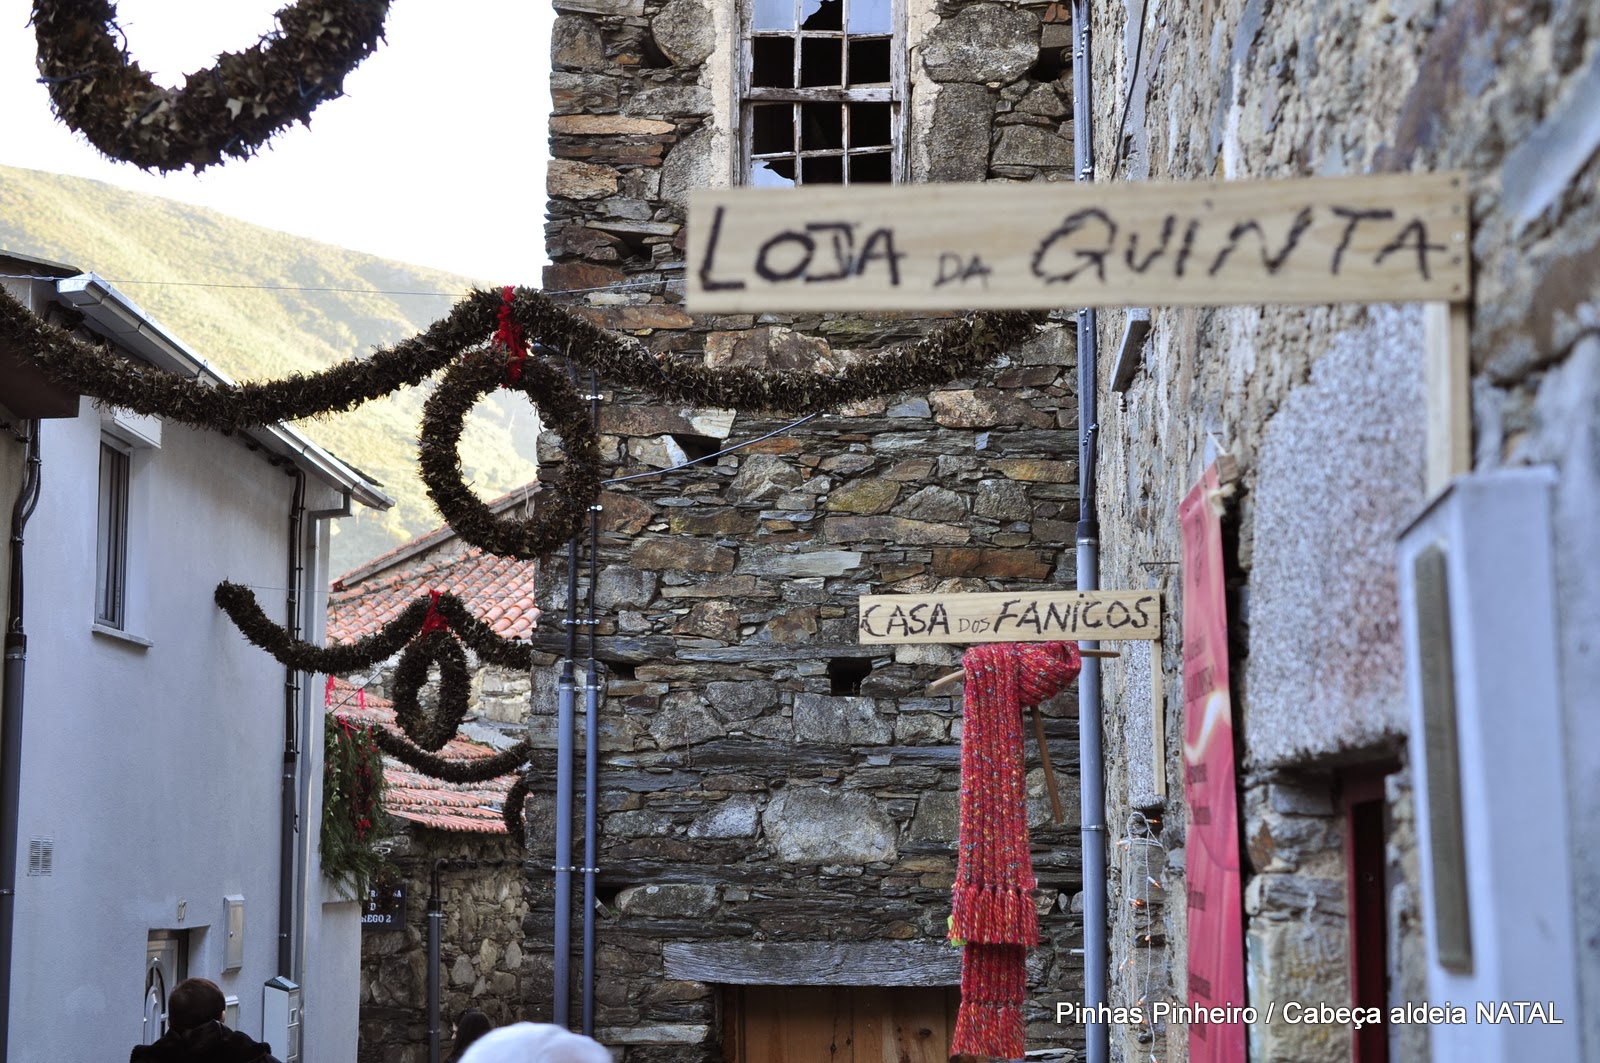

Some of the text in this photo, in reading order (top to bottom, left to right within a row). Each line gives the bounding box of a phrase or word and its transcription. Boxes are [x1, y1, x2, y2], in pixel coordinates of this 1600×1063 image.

[699, 206, 903, 291] LOJA
[934, 254, 991, 288] DA
[860, 602, 950, 637] CASA
[959, 617, 991, 633] DOS
[385, 914, 392, 923] 2
